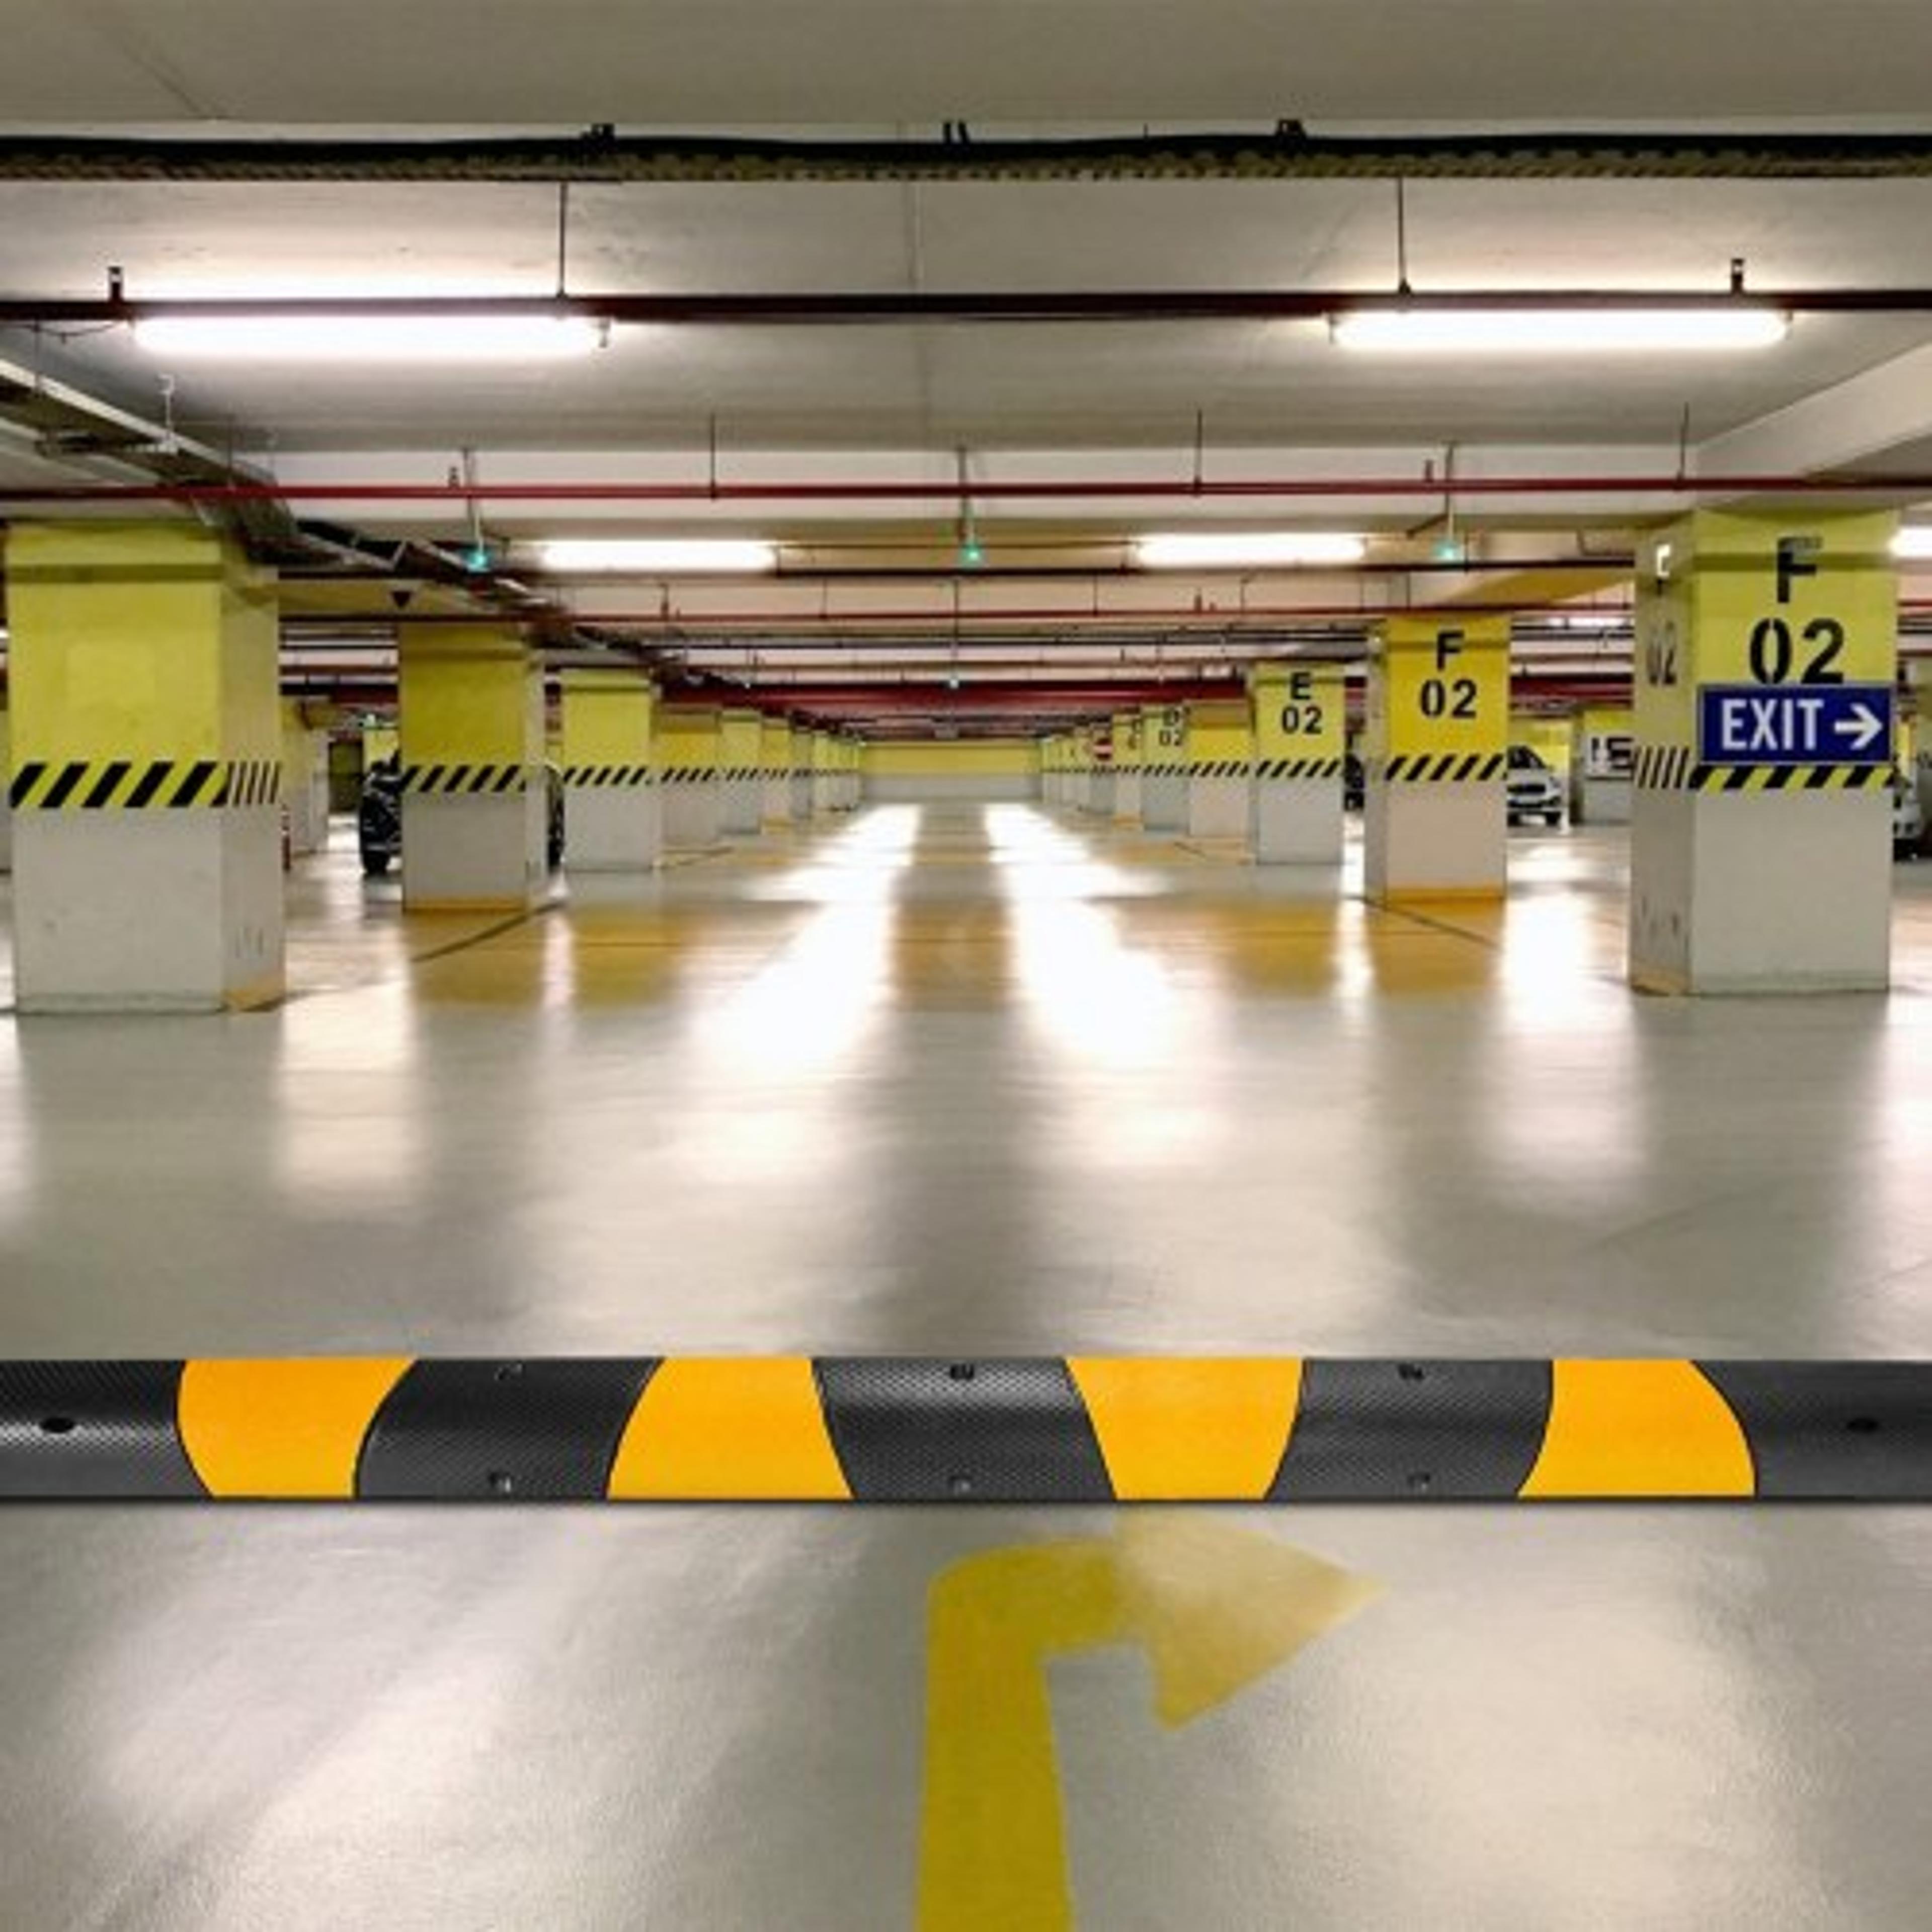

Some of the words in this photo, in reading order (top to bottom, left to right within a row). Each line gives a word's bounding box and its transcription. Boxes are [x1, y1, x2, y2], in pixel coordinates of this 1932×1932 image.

[1777, 536, 1822, 604] F
[1436, 630, 1465, 670] F
[1749, 618, 1844, 684] 02
[1290, 672, 1311, 701] E
[1420, 679, 1477, 719] 02
[1281, 705, 1322, 735] 02
[1722, 699, 1824, 750] EXIT
